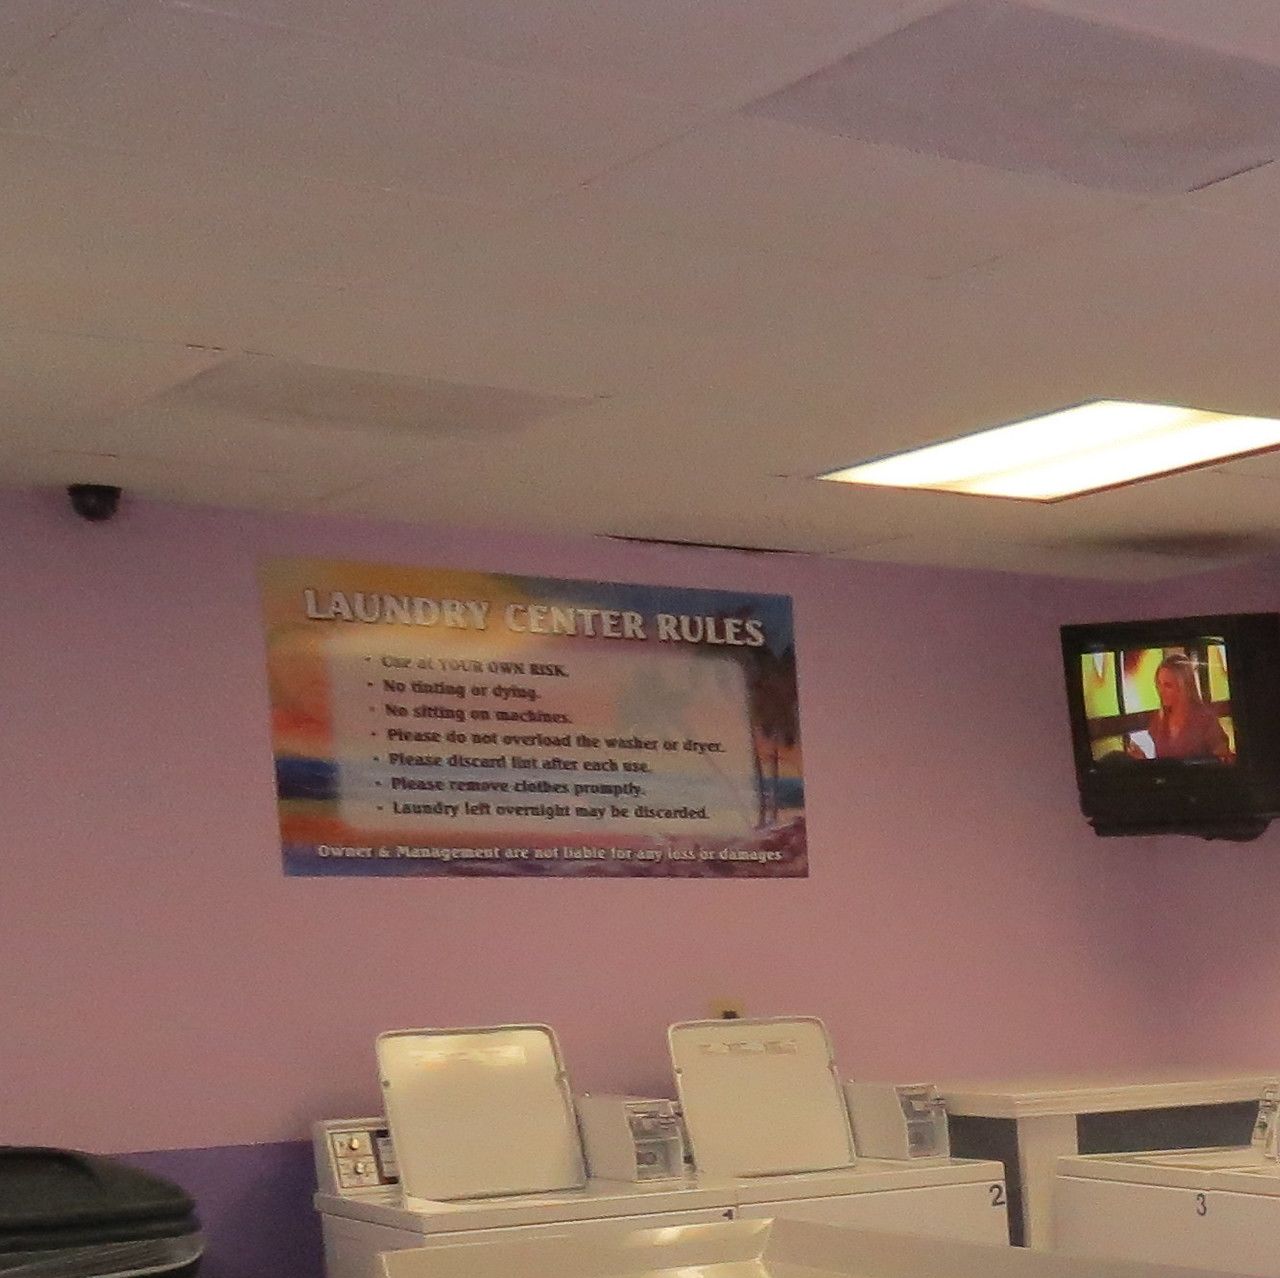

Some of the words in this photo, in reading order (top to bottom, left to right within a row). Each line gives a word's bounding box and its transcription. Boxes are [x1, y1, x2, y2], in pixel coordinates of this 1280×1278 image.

[304, 588, 489, 630] LAUNDRY
[505, 602, 648, 640] CENTER
[657, 613, 766, 647] RULES
[383, 680, 406, 692] No
[411, 682, 465, 698] tinting
[471, 687, 488, 696] or
[493, 685, 541, 701] dying.
[385, 704, 408, 716] No
[414, 706, 465, 722] sitting
[471, 710, 489, 720] on
[496, 710, 572, 724] machines.
[388, 729, 441, 742] Please
[446, 731, 466, 744] do
[472, 733, 497, 744] not
[503, 733, 571, 747] overload
[576, 734, 599, 748] the
[605, 736, 658, 750] washer
[663, 740, 679, 750] or
[683, 739, 724, 753] dryer.
[389, 753, 442, 766] Please
[448, 755, 505, 768] discard
[511, 756, 537, 769] lint
[543, 757, 578, 770] after
[583, 759, 618, 771] each
[623, 762, 652, 773] use.
[391, 777, 443, 791] Please
[450, 780, 508, 792] remove
[514, 780, 568, 793] clothes
[575, 782, 646, 798] promptly.
[394, 801, 459, 817] Laundry
[465, 802, 491, 815] left
[496, 804, 570, 820] overnight
[576, 807, 605, 822] may
[611, 806, 628, 818] be
[634, 806, 709, 819] discarded.
[318, 845, 371, 857] Owner
[379, 846, 390, 857] &
[397, 846, 499, 861] Management
[505, 848, 529, 858] are
[534, 848, 558, 858] not
[564, 847, 605, 860] liable
[611, 848, 631, 860] for
[635, 850, 663, 862] any
[668, 848, 695, 860] loss
[700, 850, 714, 860] or
[720, 848, 782, 863] damages
[990, 1185, 1006, 1206] 2
[1196, 1193, 1207, 1216] 3
